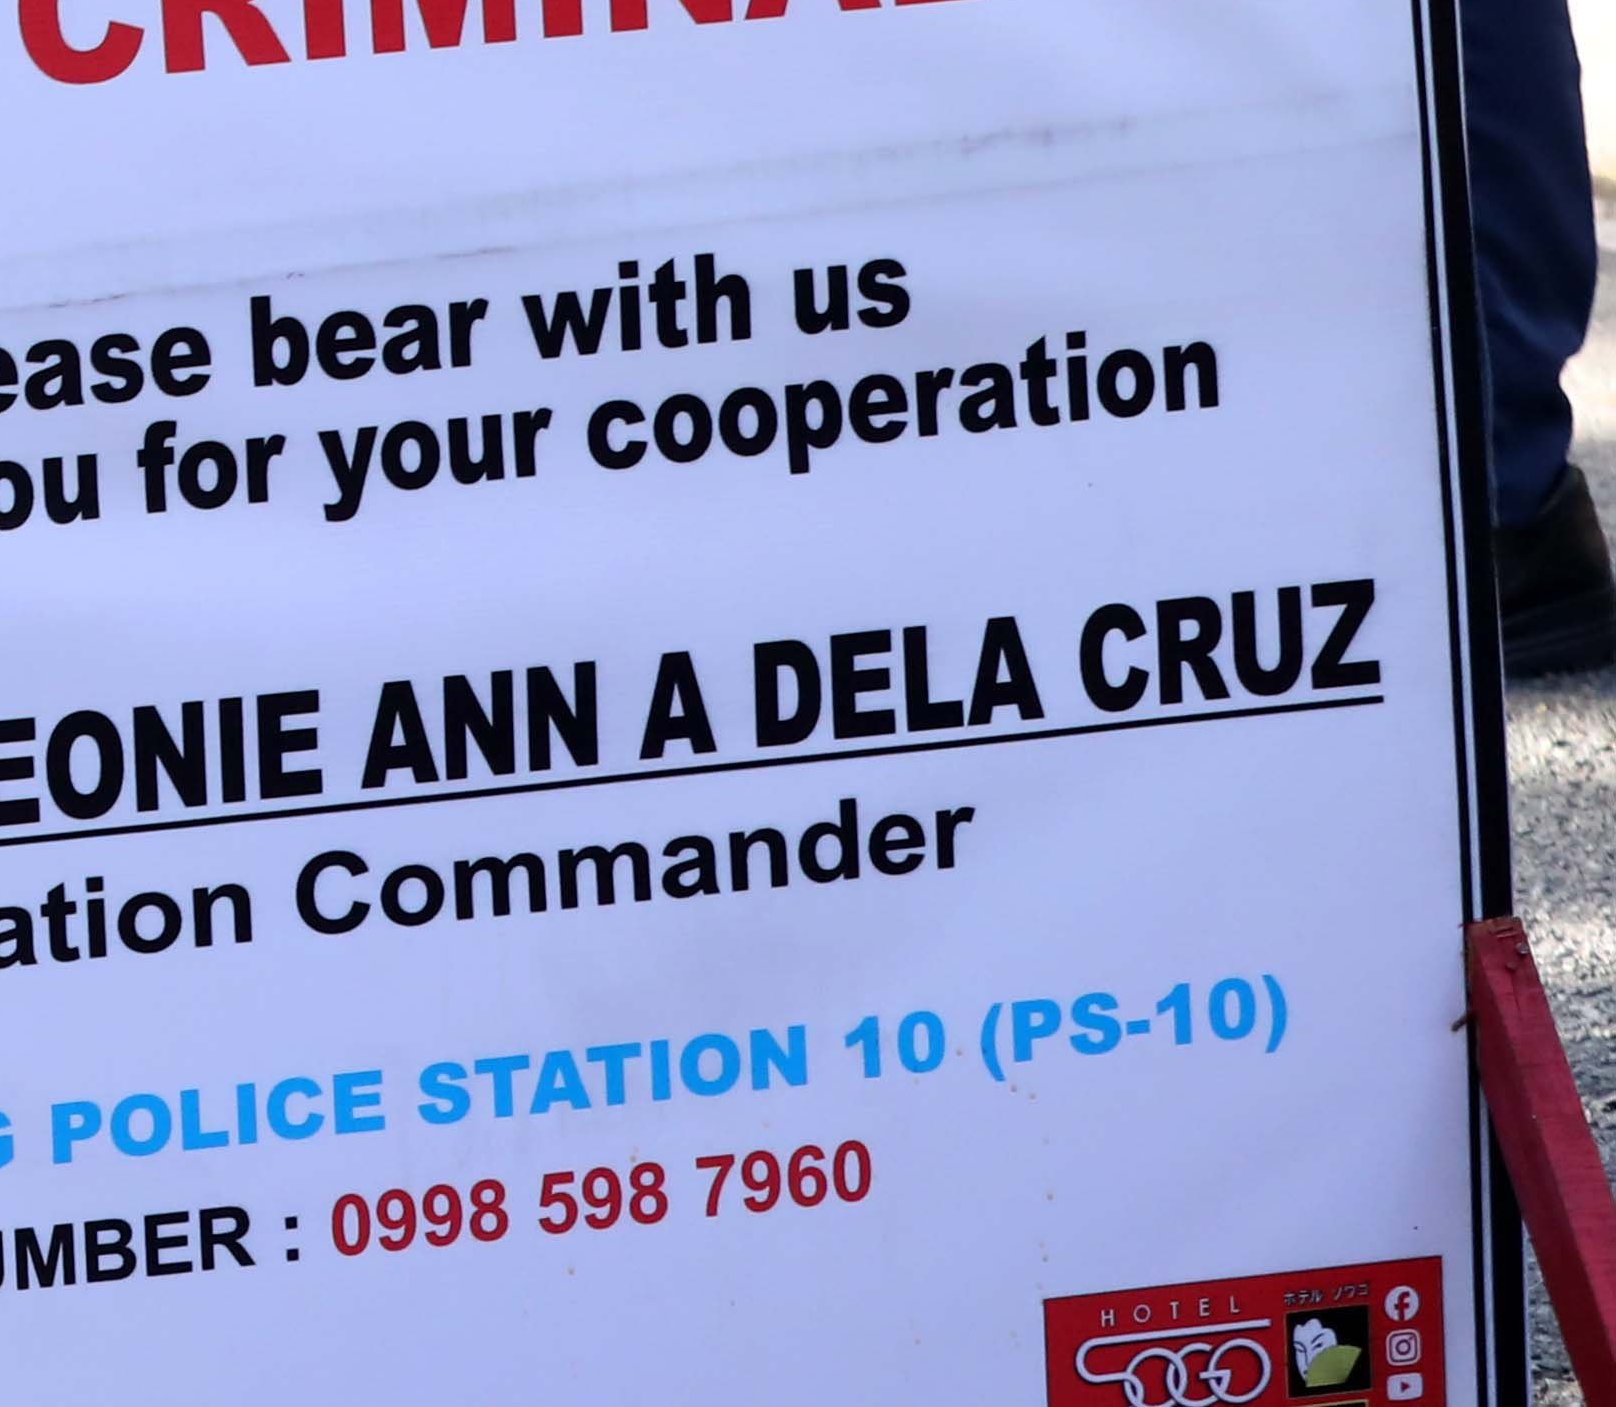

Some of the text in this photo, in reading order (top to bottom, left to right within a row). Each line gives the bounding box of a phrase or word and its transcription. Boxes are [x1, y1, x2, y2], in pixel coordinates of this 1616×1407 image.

[251, 296, 489, 386] bear
[521, 253, 751, 359] with
[794, 259, 910, 334] us
[137, 420, 286, 513] for
[318, 408, 552, 522] your
[587, 328, 1219, 474] cooperation
[361, 661, 598, 789] ANN
[640, 651, 717, 760] A
[754, 616, 1044, 747] DELA
[1080, 579, 1381, 712] CRUZ
[296, 798, 975, 934] Commander
[51, 1069, 386, 1164] POLICE
[418, 1024, 808, 1125] STATION
[844, 1010, 947, 1078] 10
[980, 974, 1289, 1082] (PS-10)
[334, 1181, 507, 1255] 0998
[542, 1163, 667, 1233] 598
[698, 1142, 870, 1215] 7960
[1100, 1295, 1241, 1328] HOTEL
